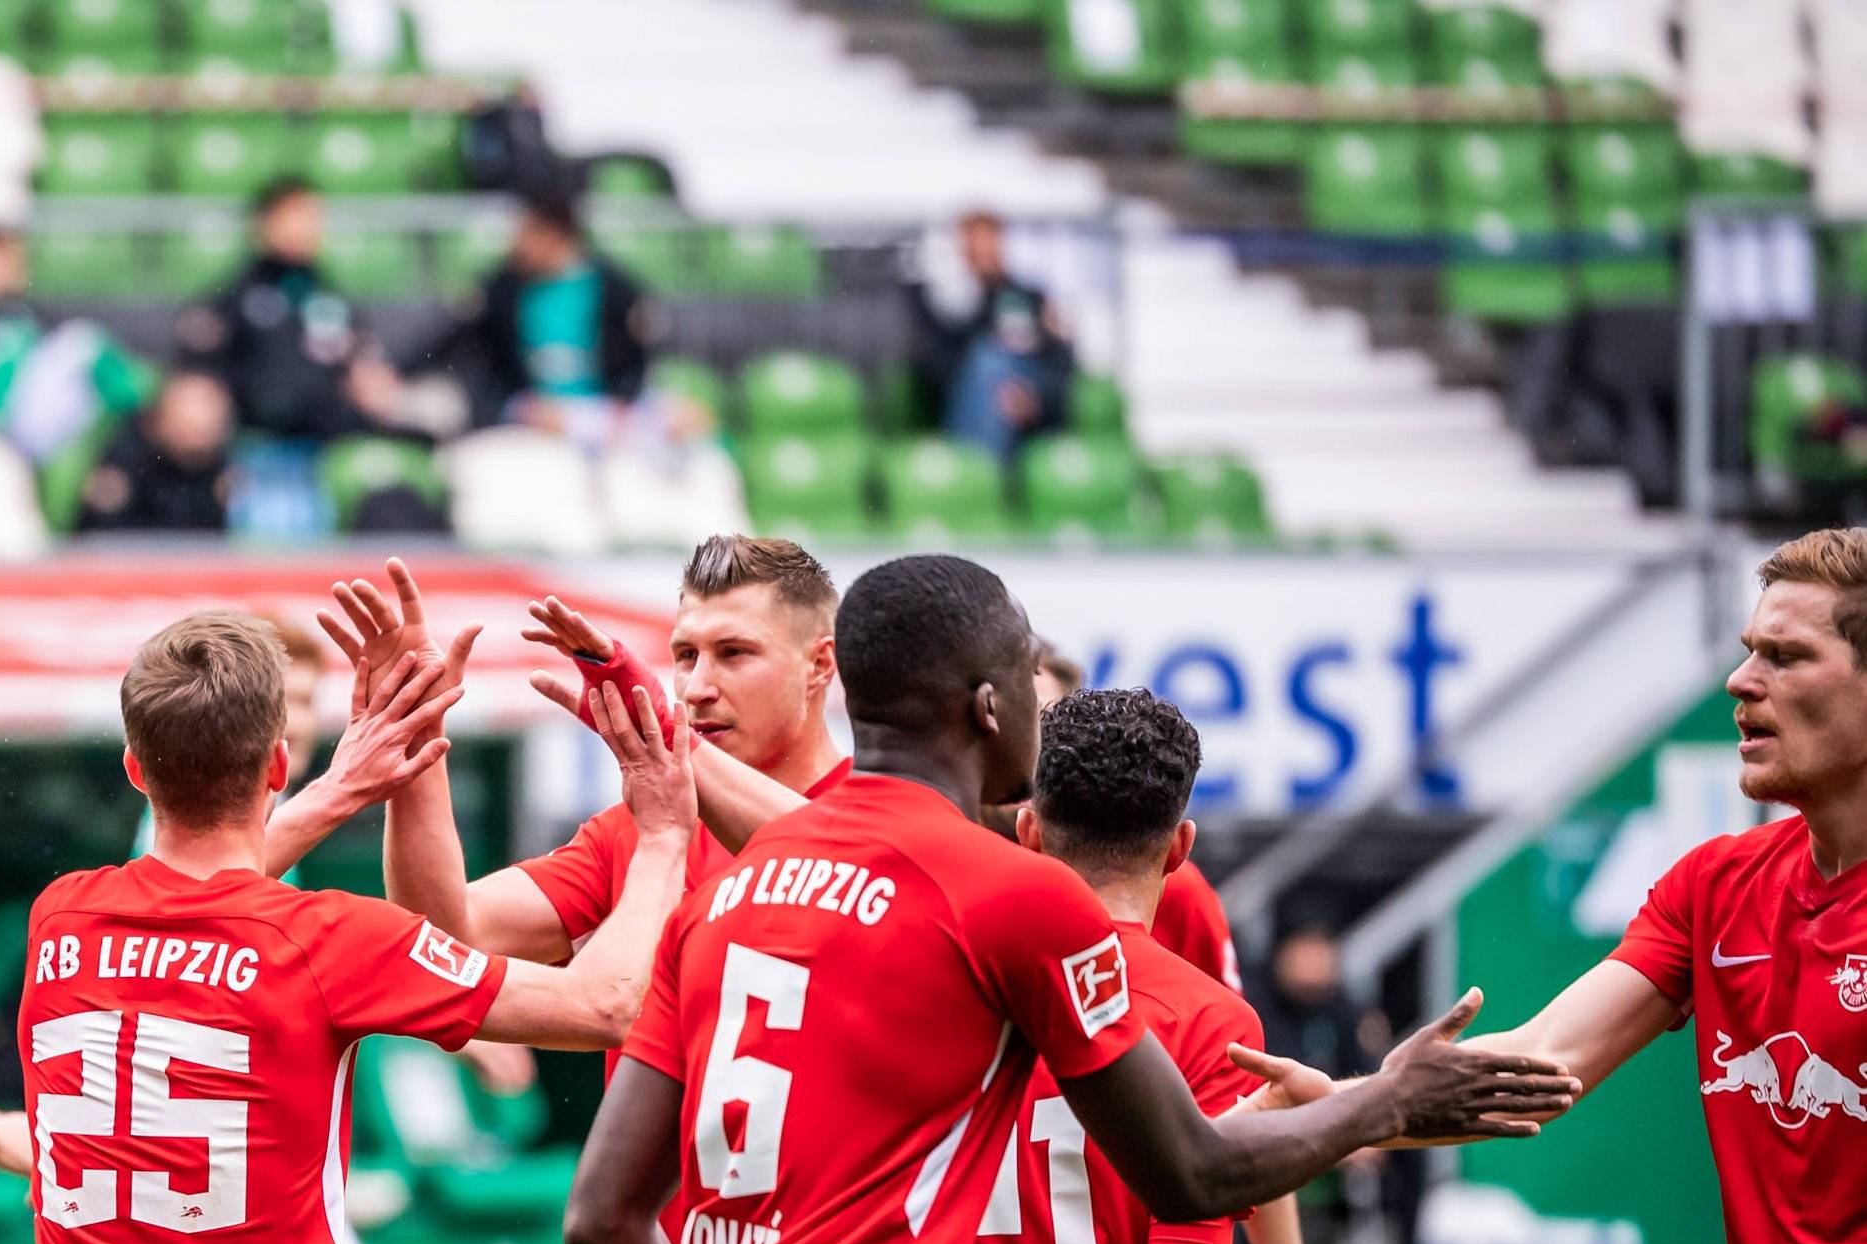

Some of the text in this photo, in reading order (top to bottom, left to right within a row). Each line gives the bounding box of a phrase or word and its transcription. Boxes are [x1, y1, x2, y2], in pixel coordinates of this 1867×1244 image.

[1091, 593, 1464, 806] est
[35, 935, 260, 992] RB LEIPZIG
[707, 858, 896, 926] RB LEIPZIG
[32, 1010, 250, 1234] 25
[695, 942, 810, 1199] 6
